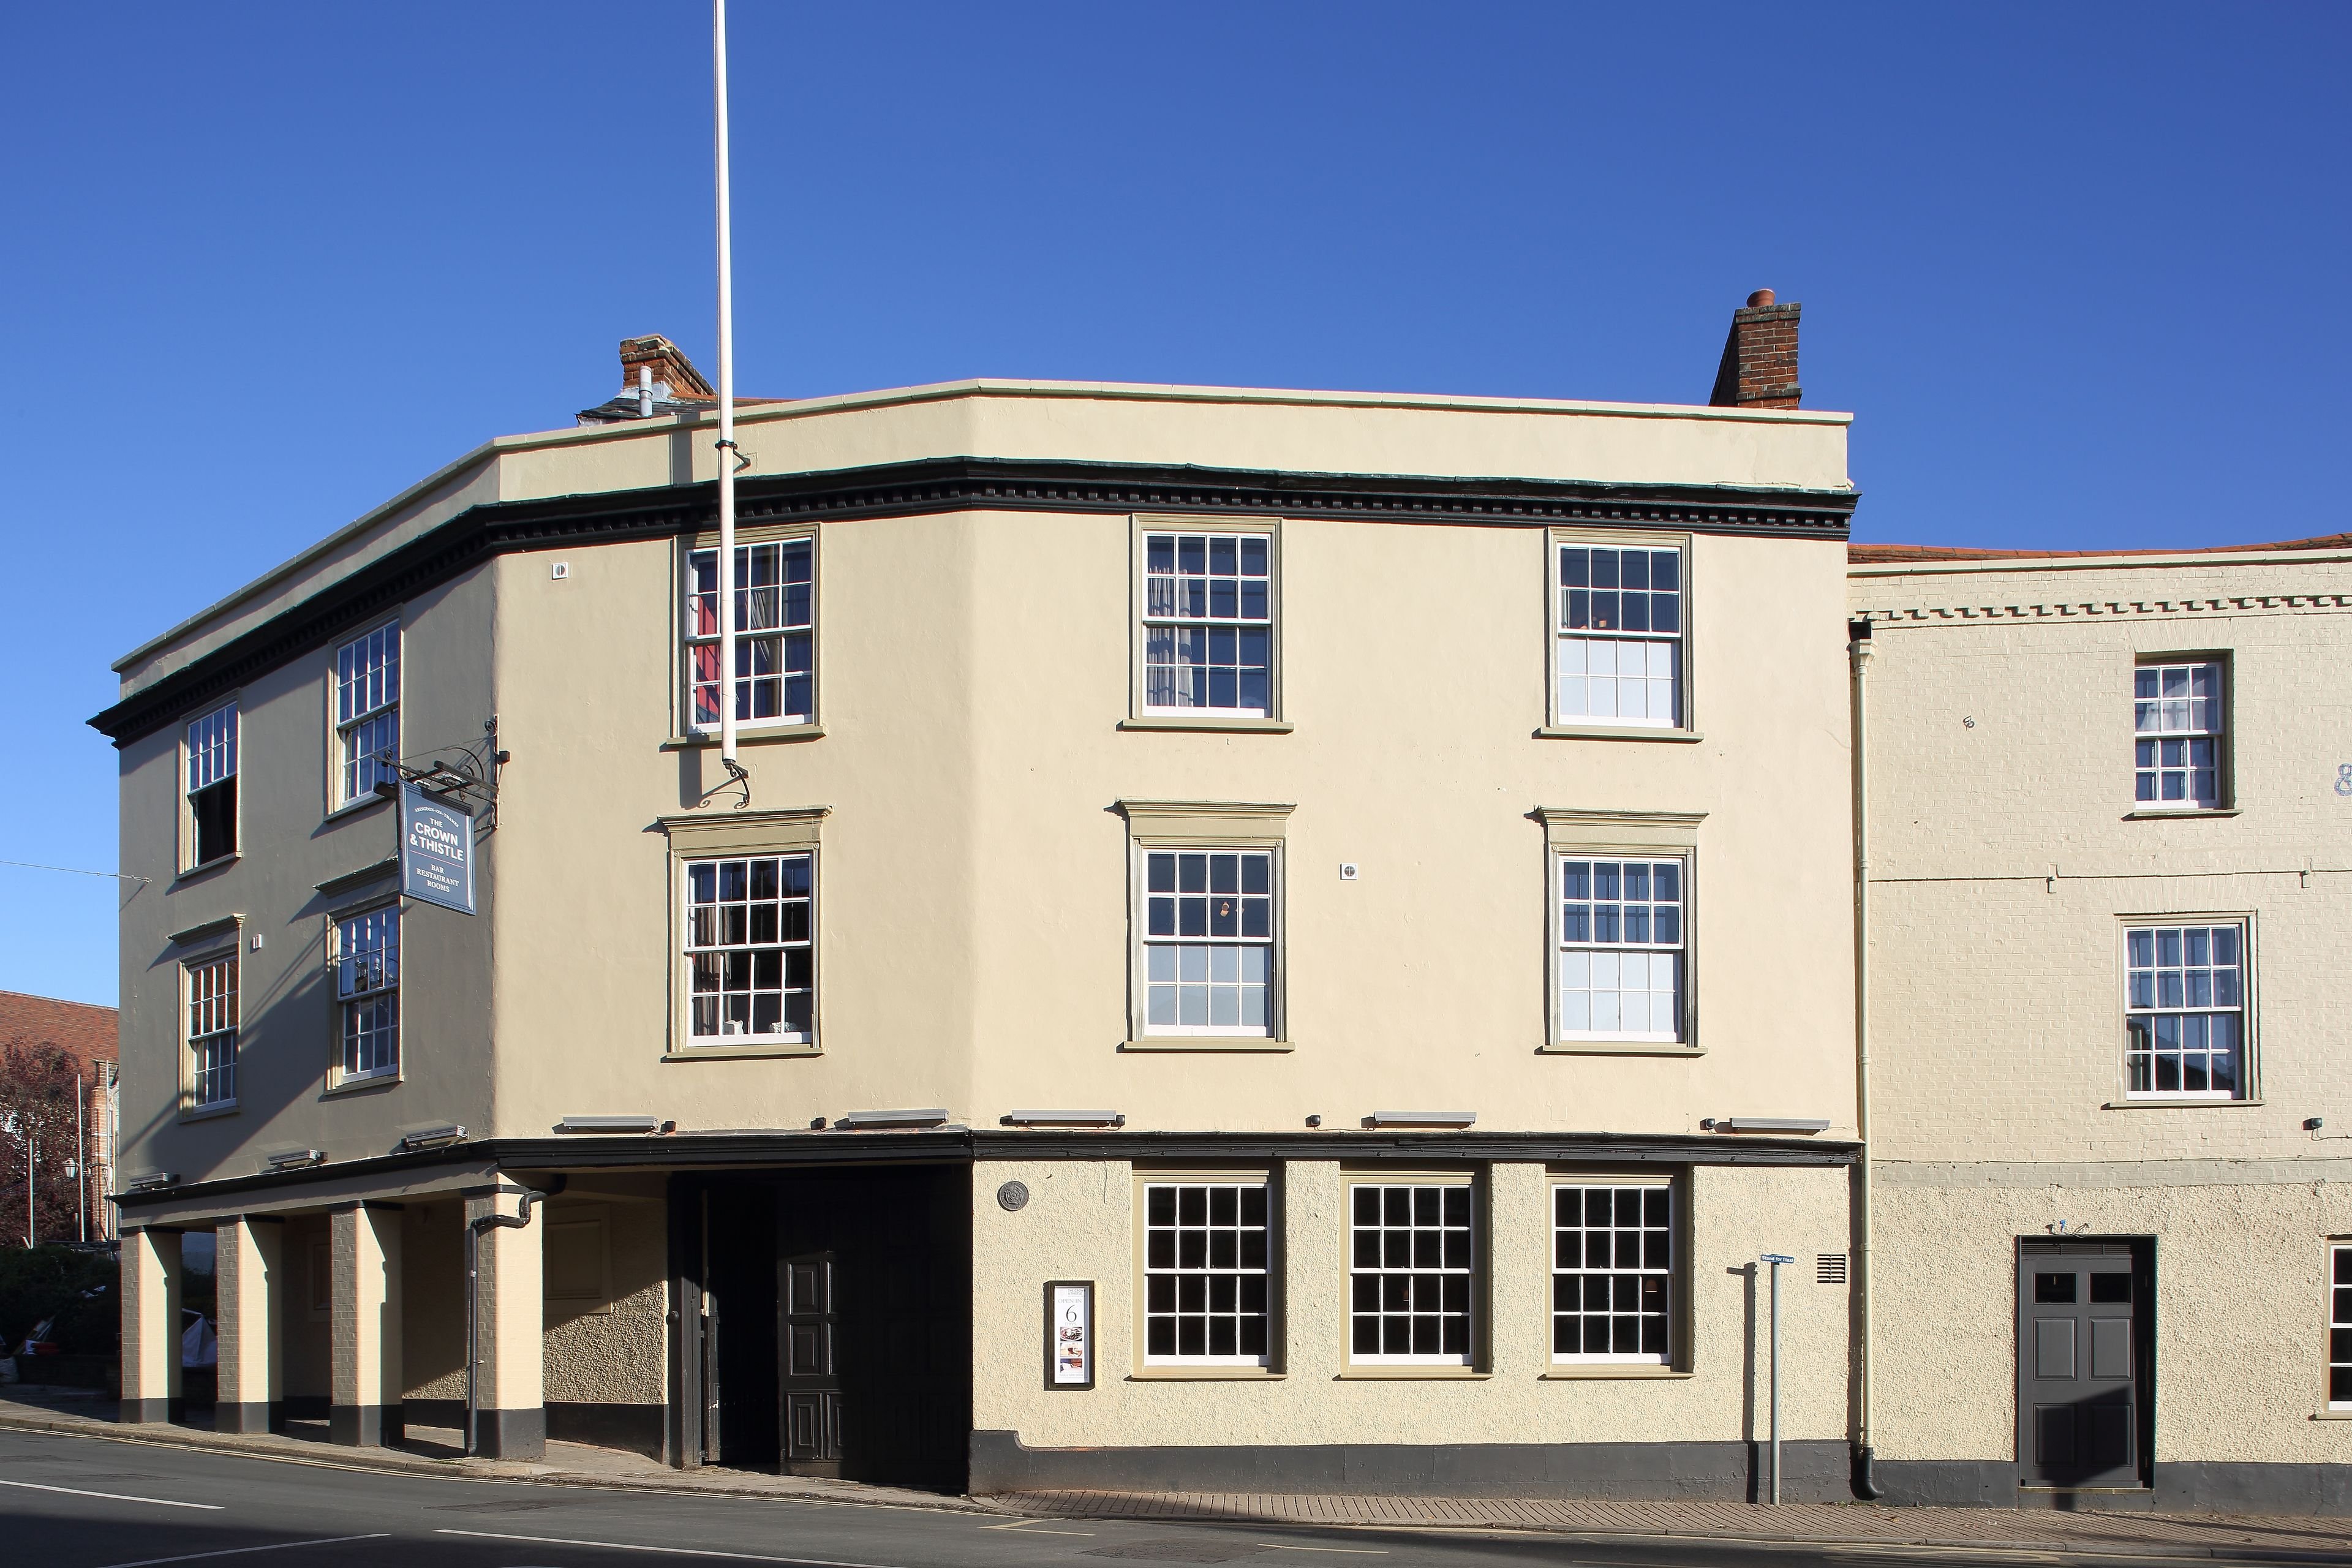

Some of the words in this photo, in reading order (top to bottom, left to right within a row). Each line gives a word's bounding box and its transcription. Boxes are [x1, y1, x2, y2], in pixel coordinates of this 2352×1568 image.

[429, 818, 443, 828] THE
[415, 821, 459, 846] CROWN
[410, 834, 418, 846] &
[419, 835, 464, 861] THISTLE
[416, 867, 459, 887] RESTAURANT
[431, 864, 445, 874] BAR
[426, 880, 450, 892] ROOMS
[1066, 1305, 1077, 1322] 6
